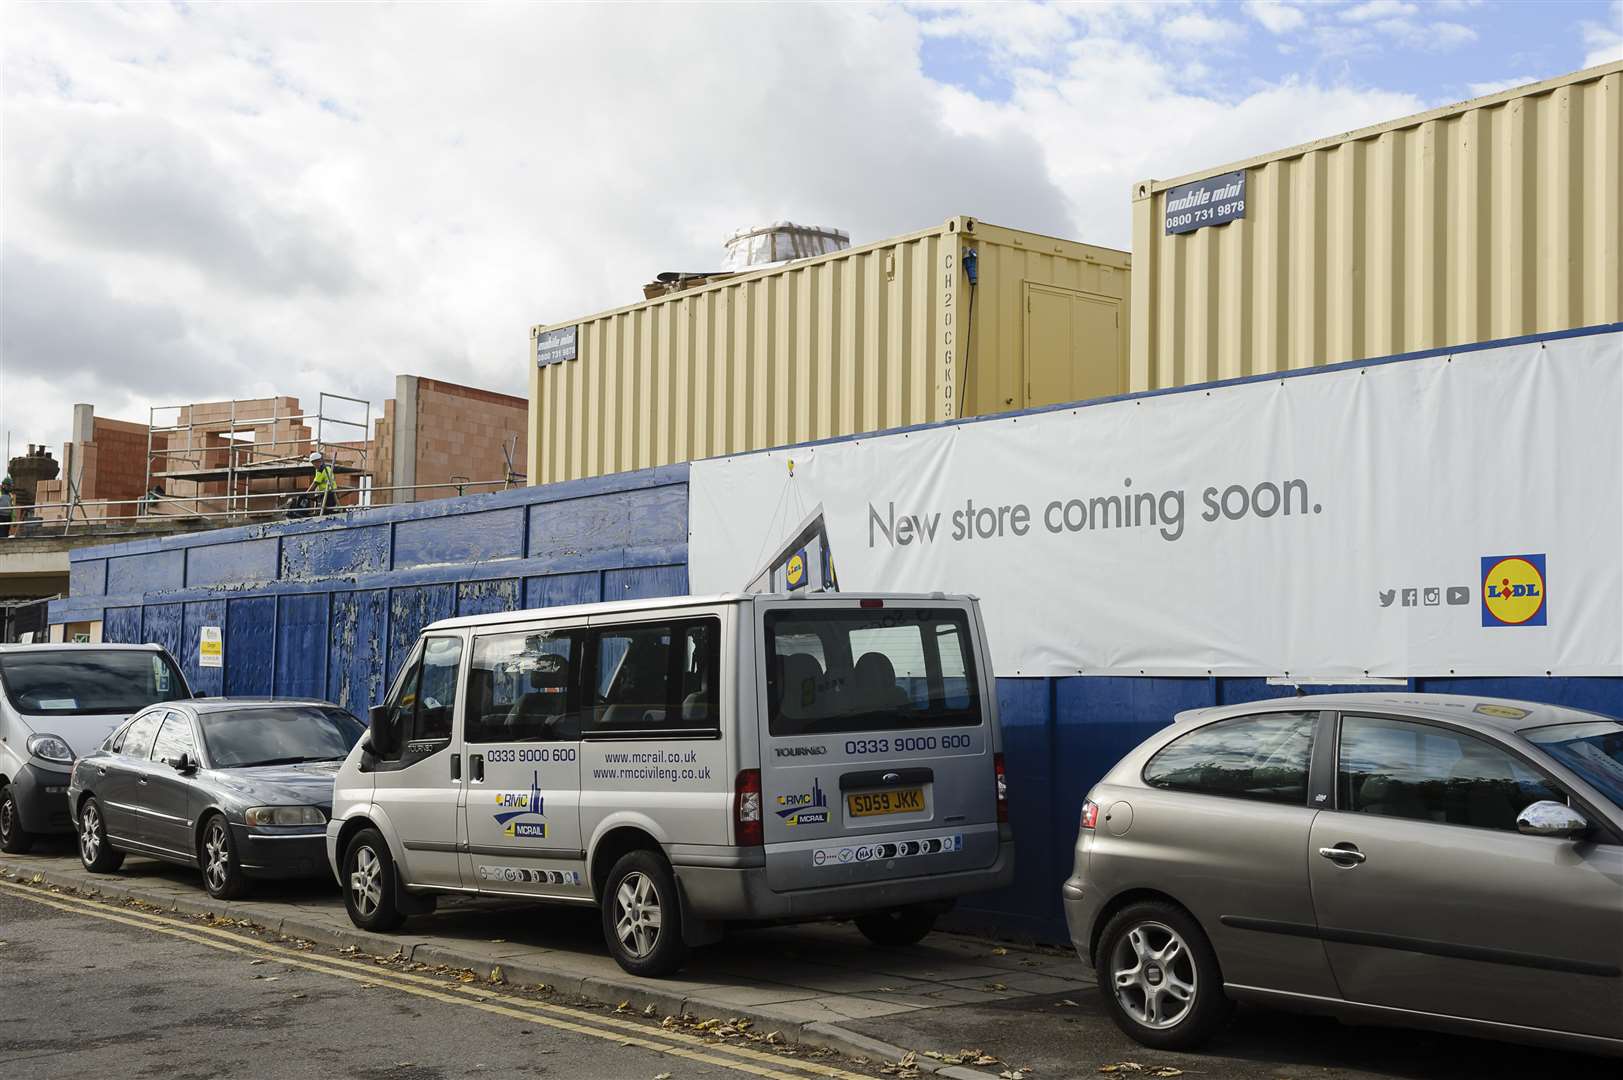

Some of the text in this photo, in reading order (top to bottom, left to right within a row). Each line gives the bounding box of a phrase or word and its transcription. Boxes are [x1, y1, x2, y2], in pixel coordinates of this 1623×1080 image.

[1166, 180, 1245, 213] mobile mini
[1166, 200, 1245, 228] 0800 731 9878
[868, 477, 1322, 548] New store coming soon.
[487, 748, 576, 762] 0333 9000 600
[845, 734, 970, 755] 0333 9000 600
[605, 750, 697, 763] www.mcrail.co.uk
[593, 766, 711, 782] www.rmccivileng.co.uk
[854, 791, 919, 812] SD59 JKK
[516, 825, 543, 836] MCRAIL
